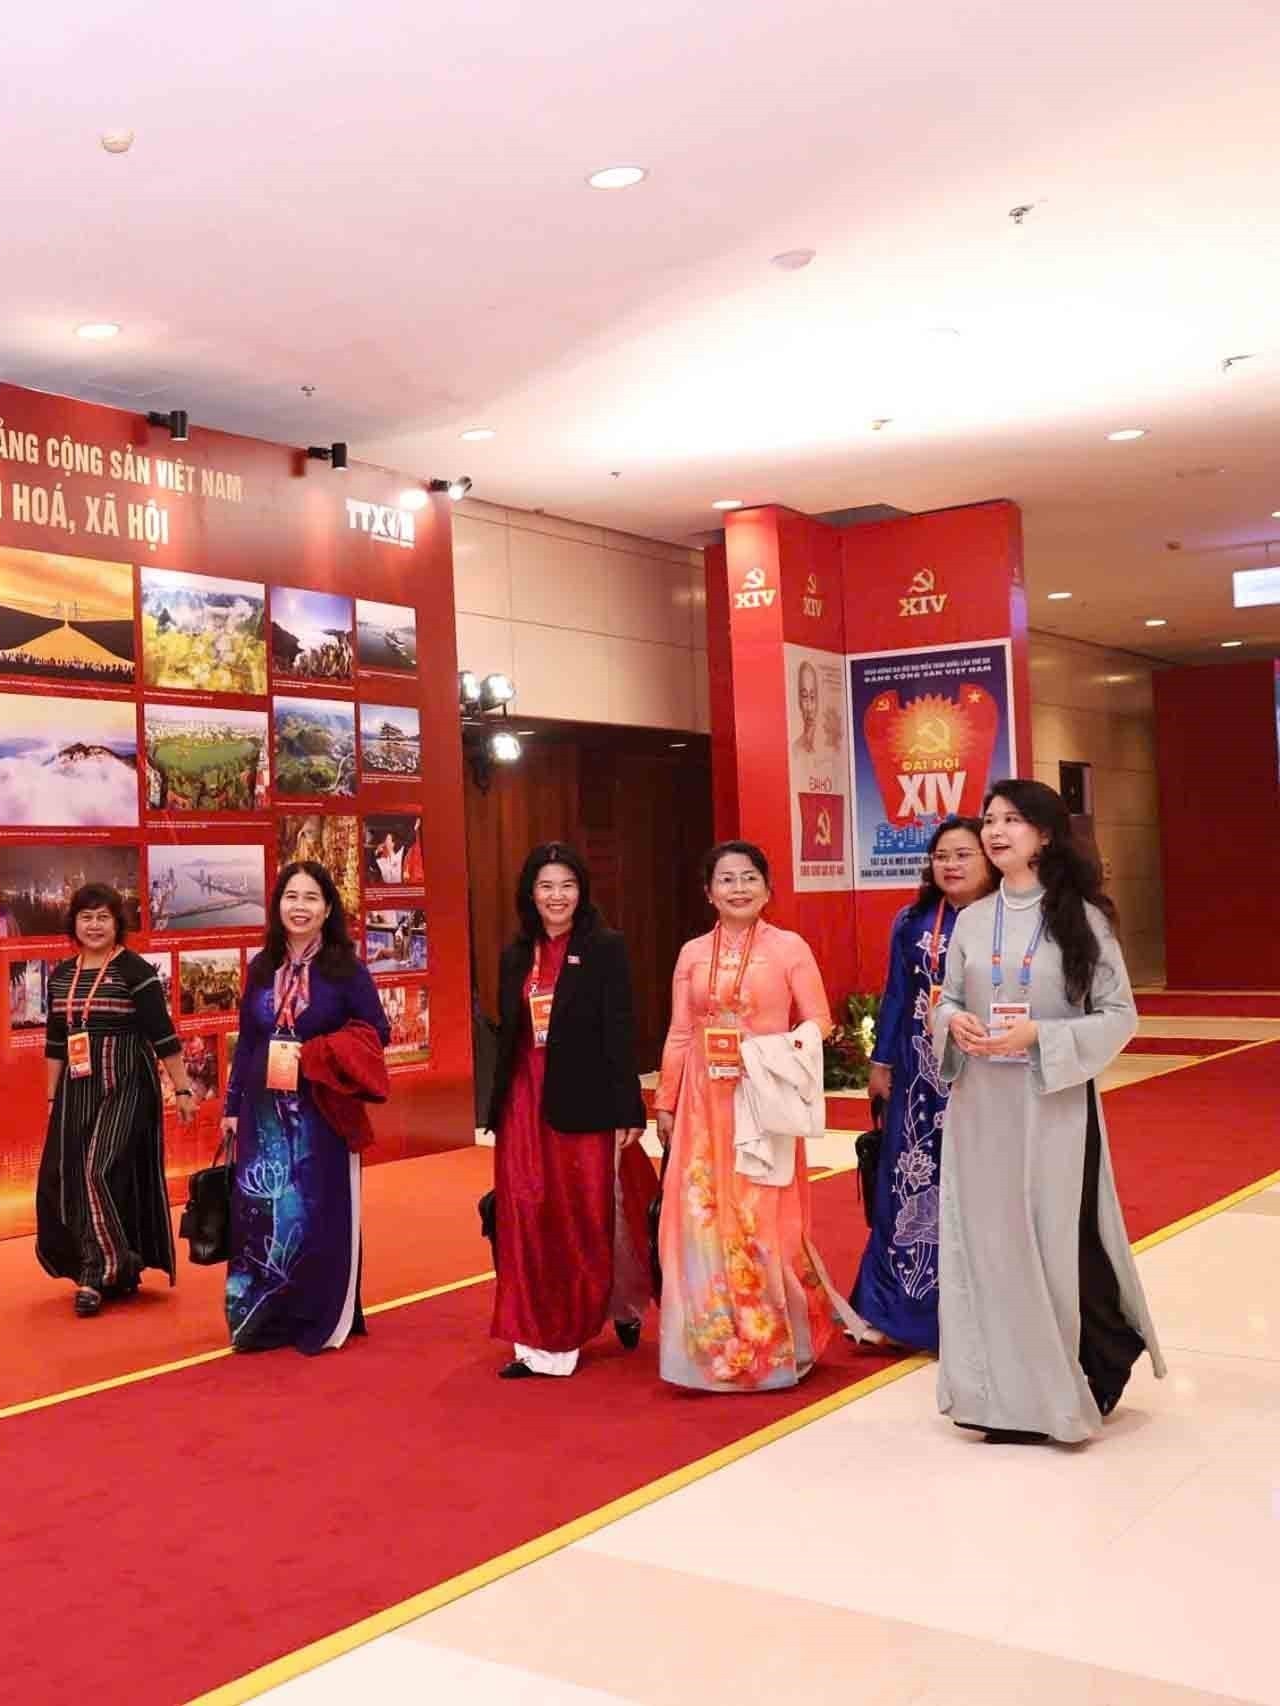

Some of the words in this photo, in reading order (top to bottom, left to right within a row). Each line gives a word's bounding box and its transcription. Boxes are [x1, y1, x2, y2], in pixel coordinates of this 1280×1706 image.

[45, 436, 104, 481] CỘNG
[110, 444, 150, 486] SẢN
[156, 455, 196, 499] VIỆT
[201, 469, 244, 503] NAM
[12, 482, 76, 535] HOÁ,
[85, 491, 121, 538] XÃ
[126, 497, 170, 551] HỘI
[734, 589, 776, 609] XIV
[802, 597, 822, 617] XIV
[898, 594, 948, 617] XIV
[896, 771, 967, 817] XIV
